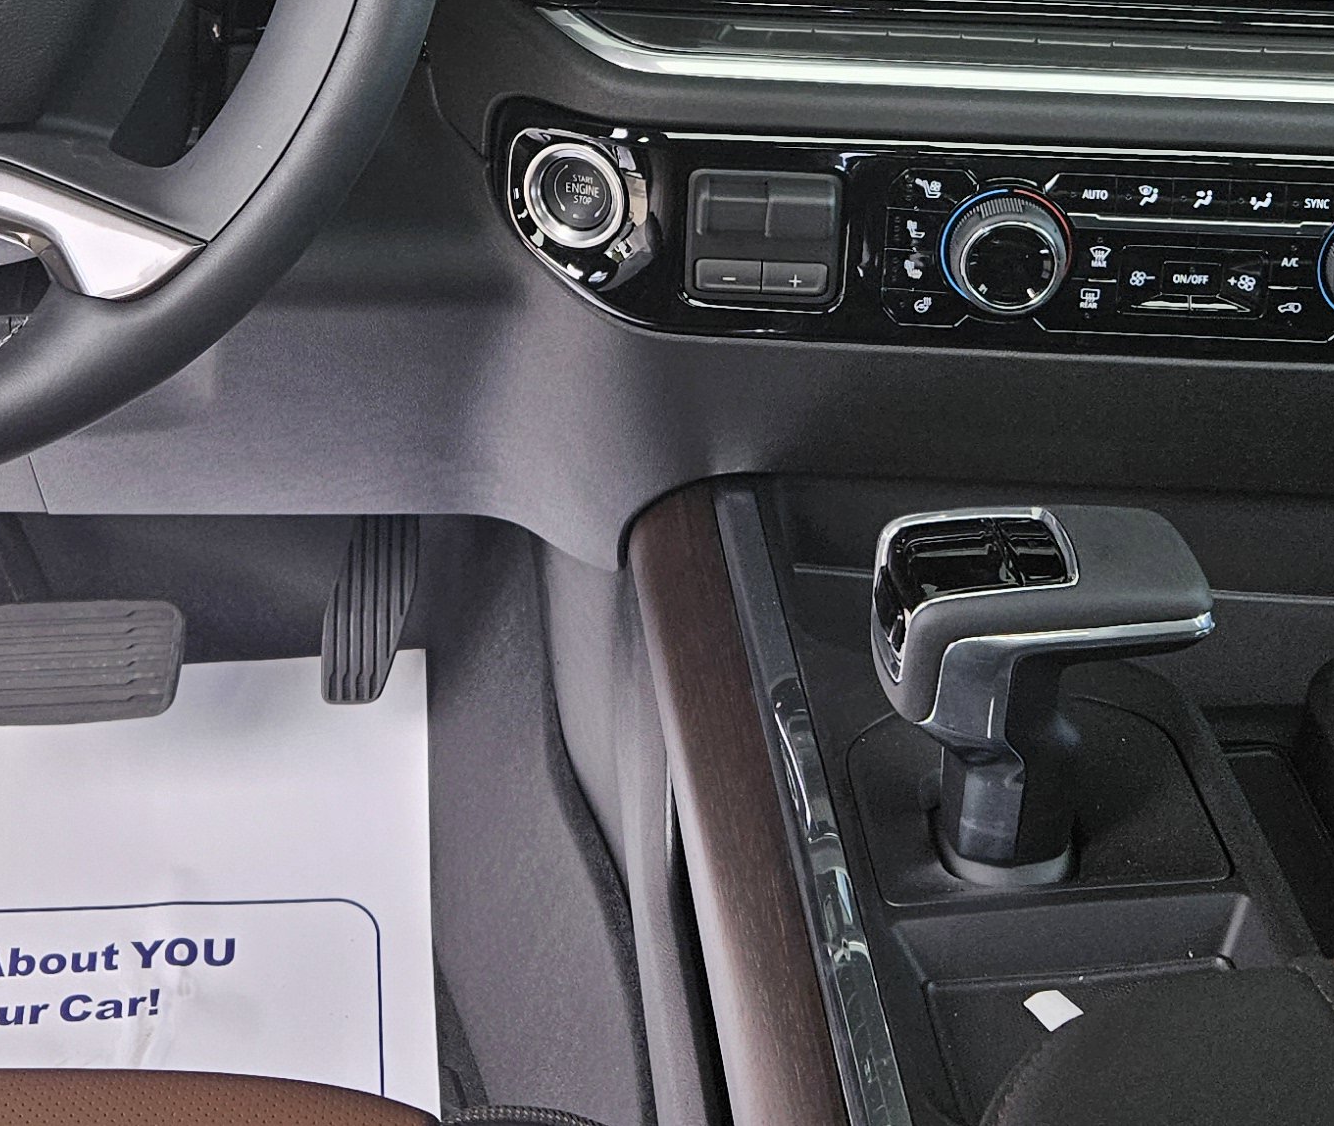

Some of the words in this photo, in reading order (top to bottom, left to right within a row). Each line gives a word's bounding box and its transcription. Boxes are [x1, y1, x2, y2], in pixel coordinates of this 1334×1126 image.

[572, 174, 594, 185] START
[565, 181, 600, 199] ENGINE
[1082, 189, 1109, 201] AUTO
[573, 194, 593, 205] STOP
[1304, 198, 1330, 210] SYNC
[1091, 260, 1107, 268] MAX
[1281, 257, 1299, 268] A/C
[1173, 274, 1209, 285] ON/OFF
[1079, 301, 1098, 310] REAR
[130, 936, 236, 969] YOU
[59, 988, 161, 1023] Car!
